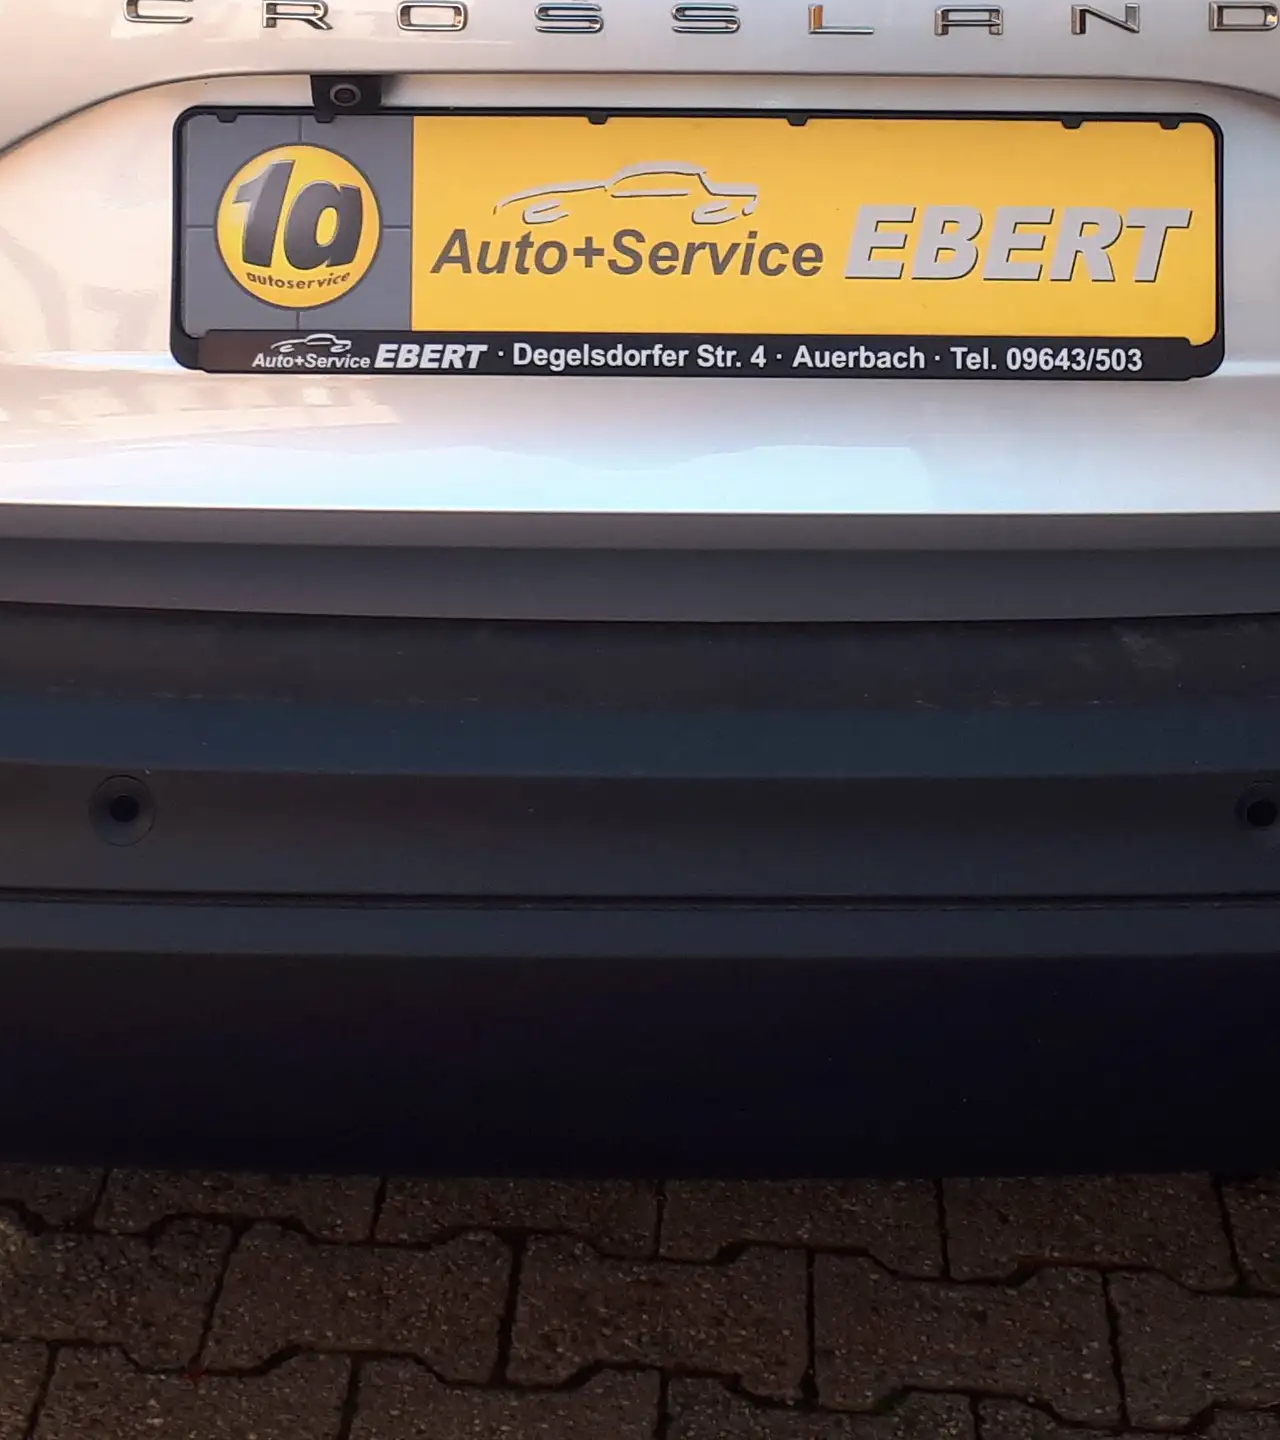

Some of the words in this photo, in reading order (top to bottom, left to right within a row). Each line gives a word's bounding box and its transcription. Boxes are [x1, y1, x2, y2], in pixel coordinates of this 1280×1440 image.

[232, 158, 363, 270] 1a
[429, 228, 823, 277] Auto+Service
[843, 203, 1193, 283] EBERT
[245, 271, 351, 290] autoservice
[251, 353, 371, 369] Auto+Service
[373, 343, 488, 370] EBERT
[512, 342, 689, 371] Degelsdorfer
[696, 344, 742, 368] Str.
[750, 345, 767, 368] 4
[792, 345, 926, 370] Auerbach
[950, 346, 997, 371] Tel.
[1005, 347, 1143, 372] 09643/503
